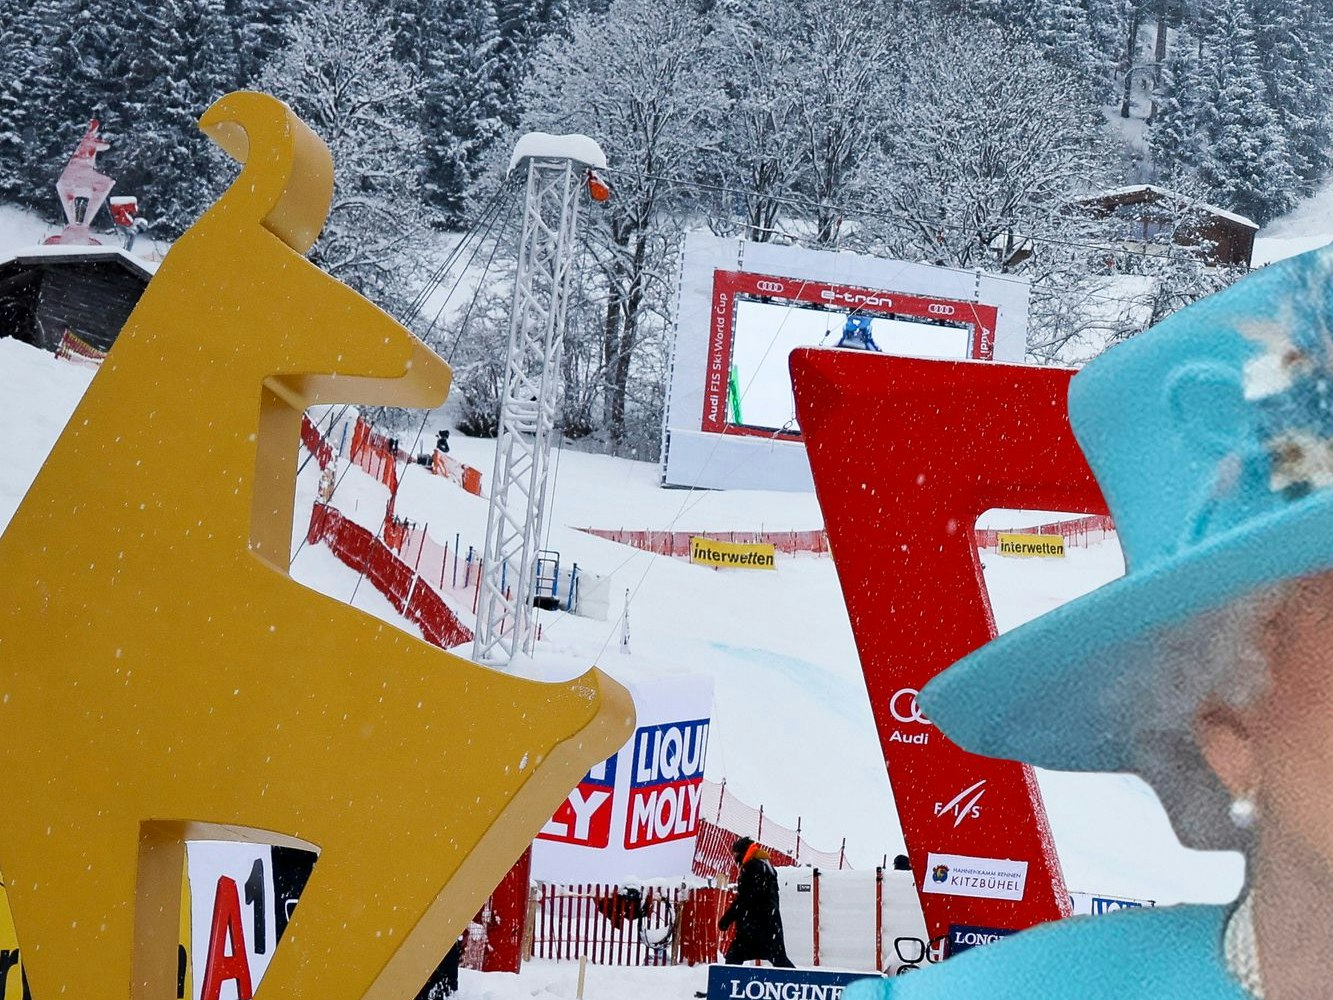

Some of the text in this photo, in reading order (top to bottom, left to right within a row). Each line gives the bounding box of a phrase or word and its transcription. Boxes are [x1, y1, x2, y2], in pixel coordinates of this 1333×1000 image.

[718, 293, 727, 314] Cup
[821, 290, 892, 307] e-tron
[715, 317, 725, 351] World
[711, 372, 720, 393] FIS
[708, 395, 718, 422] Audi
[693, 542, 774, 567] interwetten
[1001, 540, 1064, 554] interwetten
[889, 731, 929, 745] Audi
[636, 724, 709, 783] LIQUI
[630, 782, 703, 844] MOLY
[953, 867, 996, 878] HAHNENKAMM
[951, 876, 1019, 892] KITZBÜHEL
[955, 932, 1001, 946] LONG
